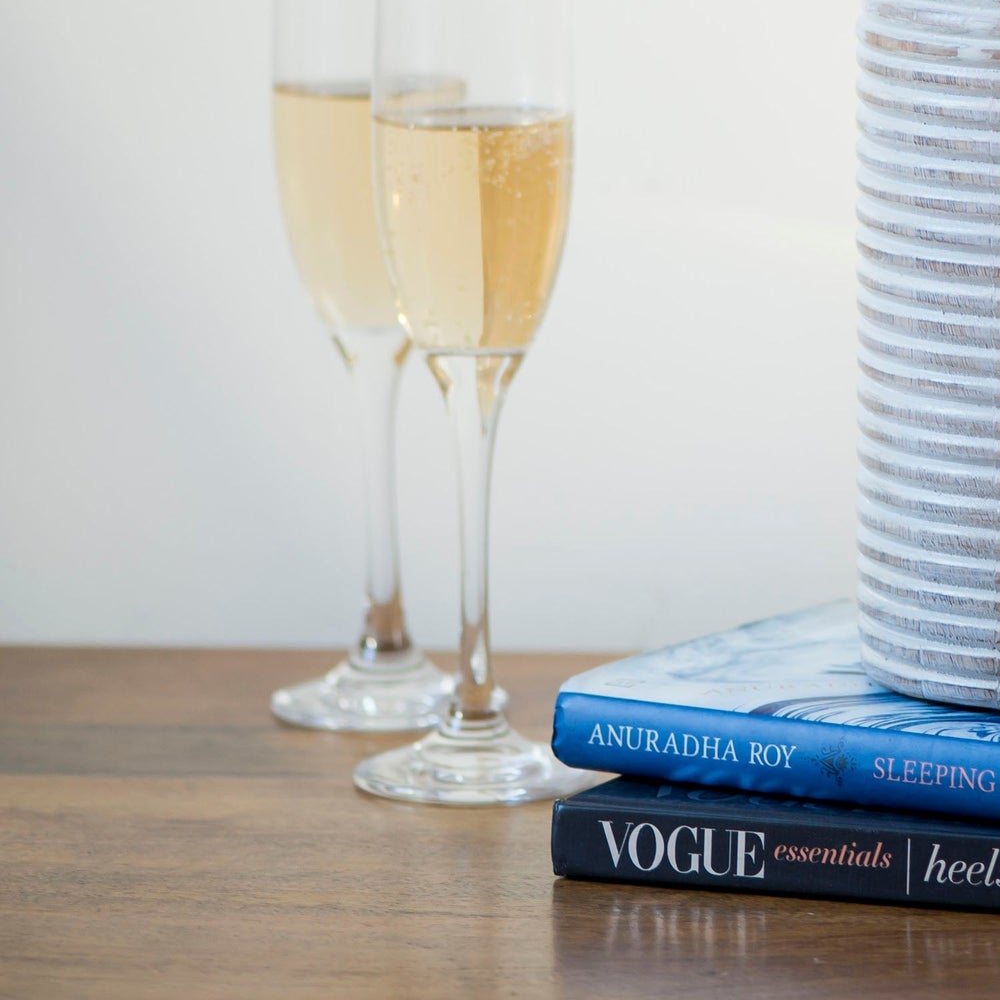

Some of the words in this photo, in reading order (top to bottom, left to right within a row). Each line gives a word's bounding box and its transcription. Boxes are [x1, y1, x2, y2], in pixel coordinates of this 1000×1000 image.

[587, 722, 740, 763] ANURADHA
[748, 741, 798, 769] ROY
[872, 756, 997, 794] SLEEPING
[598, 820, 766, 879] VOGUE
[773, 841, 893, 869] essentials
